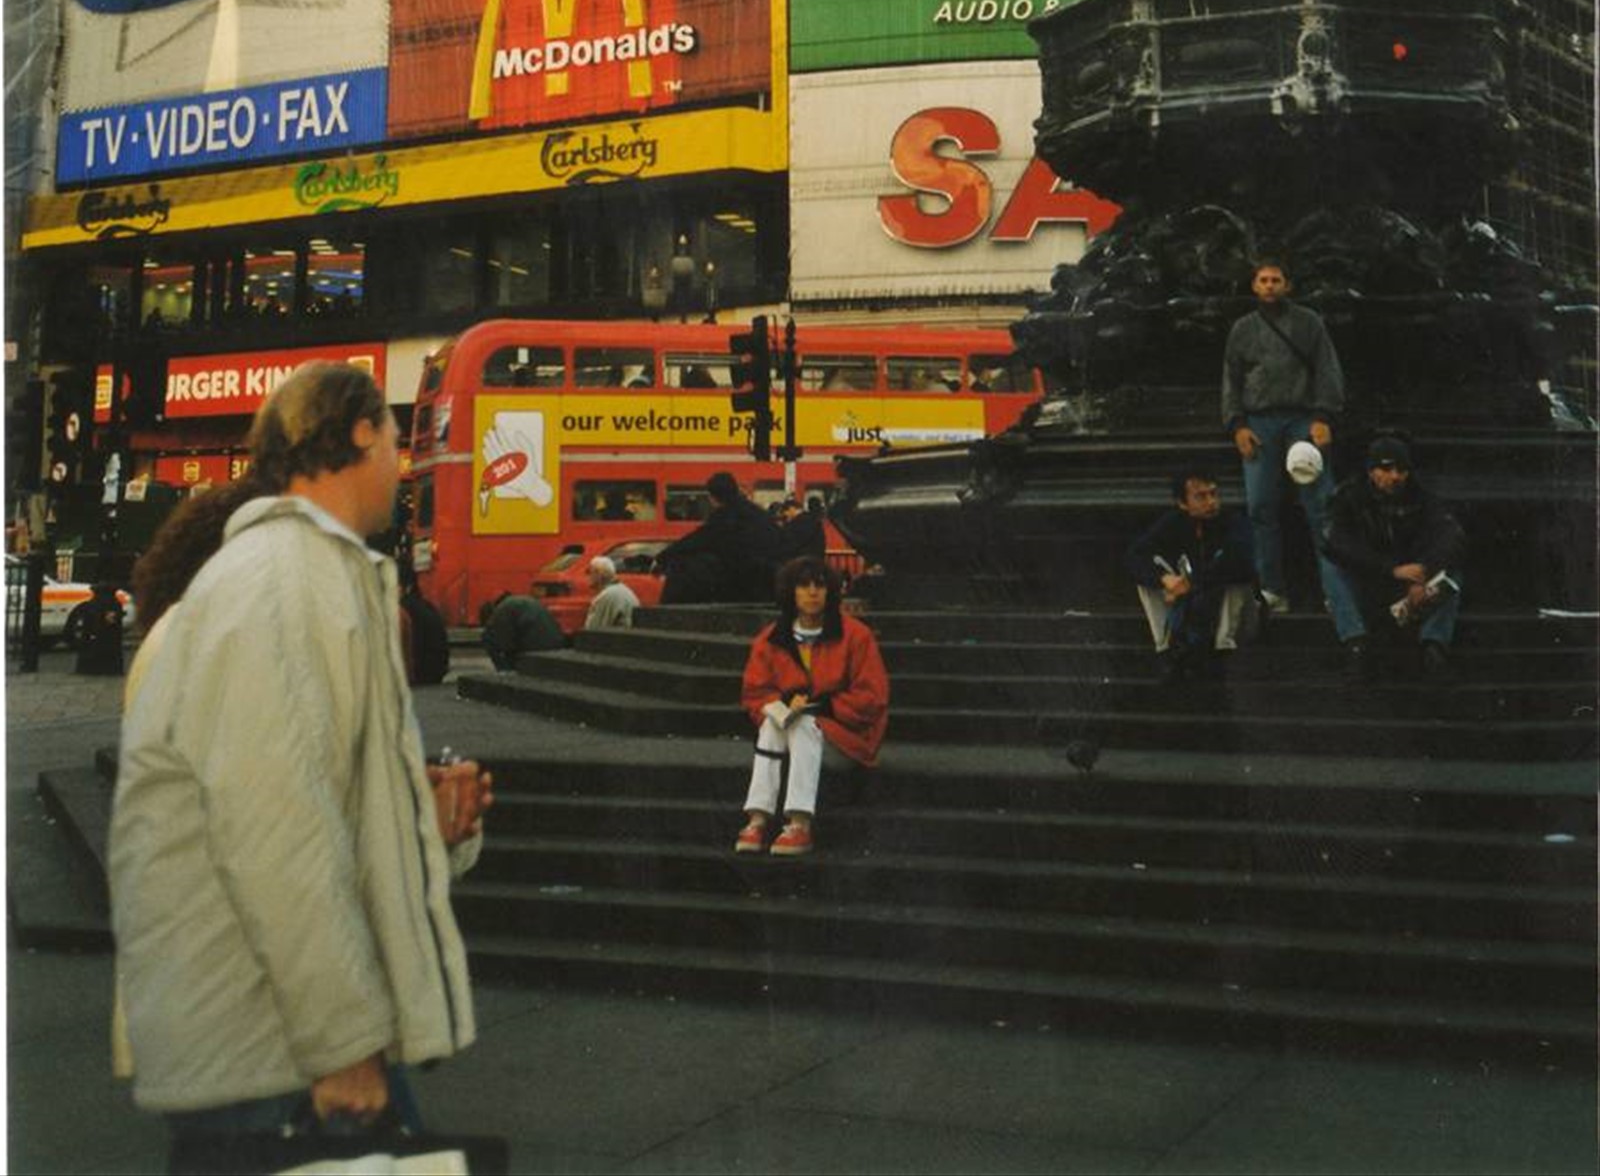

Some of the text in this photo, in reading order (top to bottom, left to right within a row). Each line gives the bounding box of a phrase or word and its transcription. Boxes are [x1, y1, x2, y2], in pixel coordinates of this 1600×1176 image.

[492, 23, 695, 78] McDonald's
[80, 82, 349, 167] TV VIDEO FAX
[540, 123, 658, 186] Carlsberg
[166, 365, 294, 402] URGER KIN
[562, 409, 782, 436] our welcome pak
[847, 424, 883, 442] just
